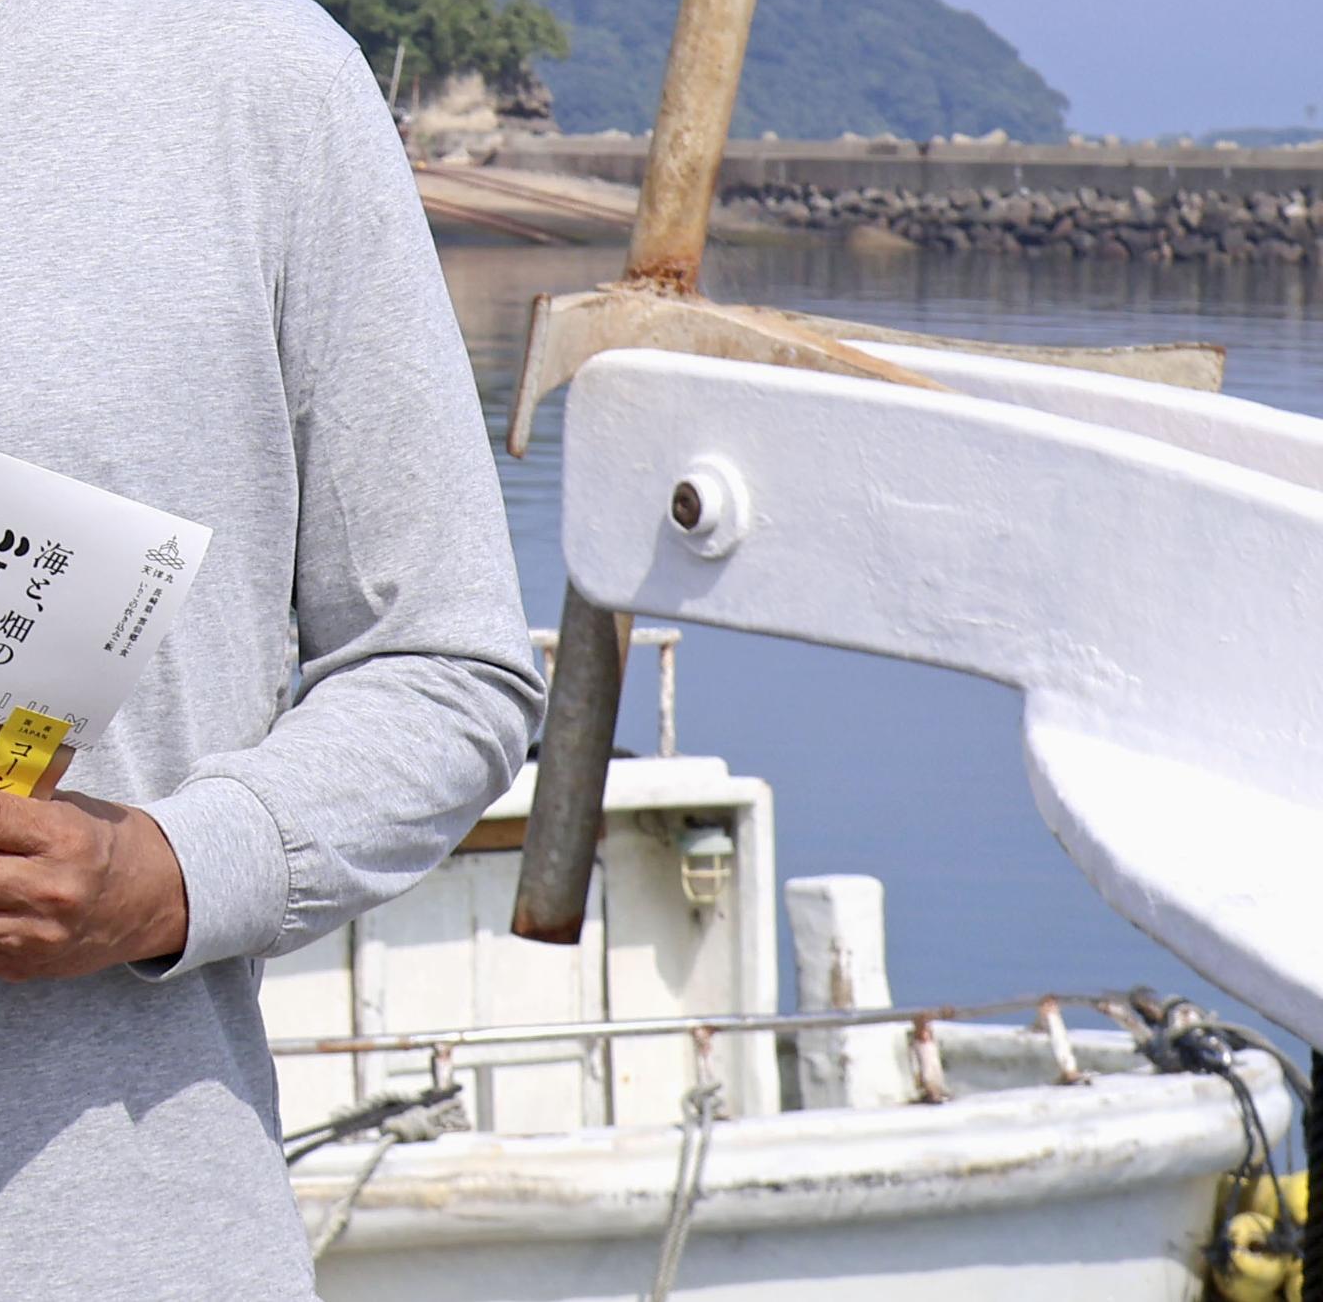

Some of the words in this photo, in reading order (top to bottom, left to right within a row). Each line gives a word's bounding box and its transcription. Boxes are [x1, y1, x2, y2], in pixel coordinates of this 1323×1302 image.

[141, 564, 174, 584] 天洋丸
[19, 727, 49, 740] JAPAN
